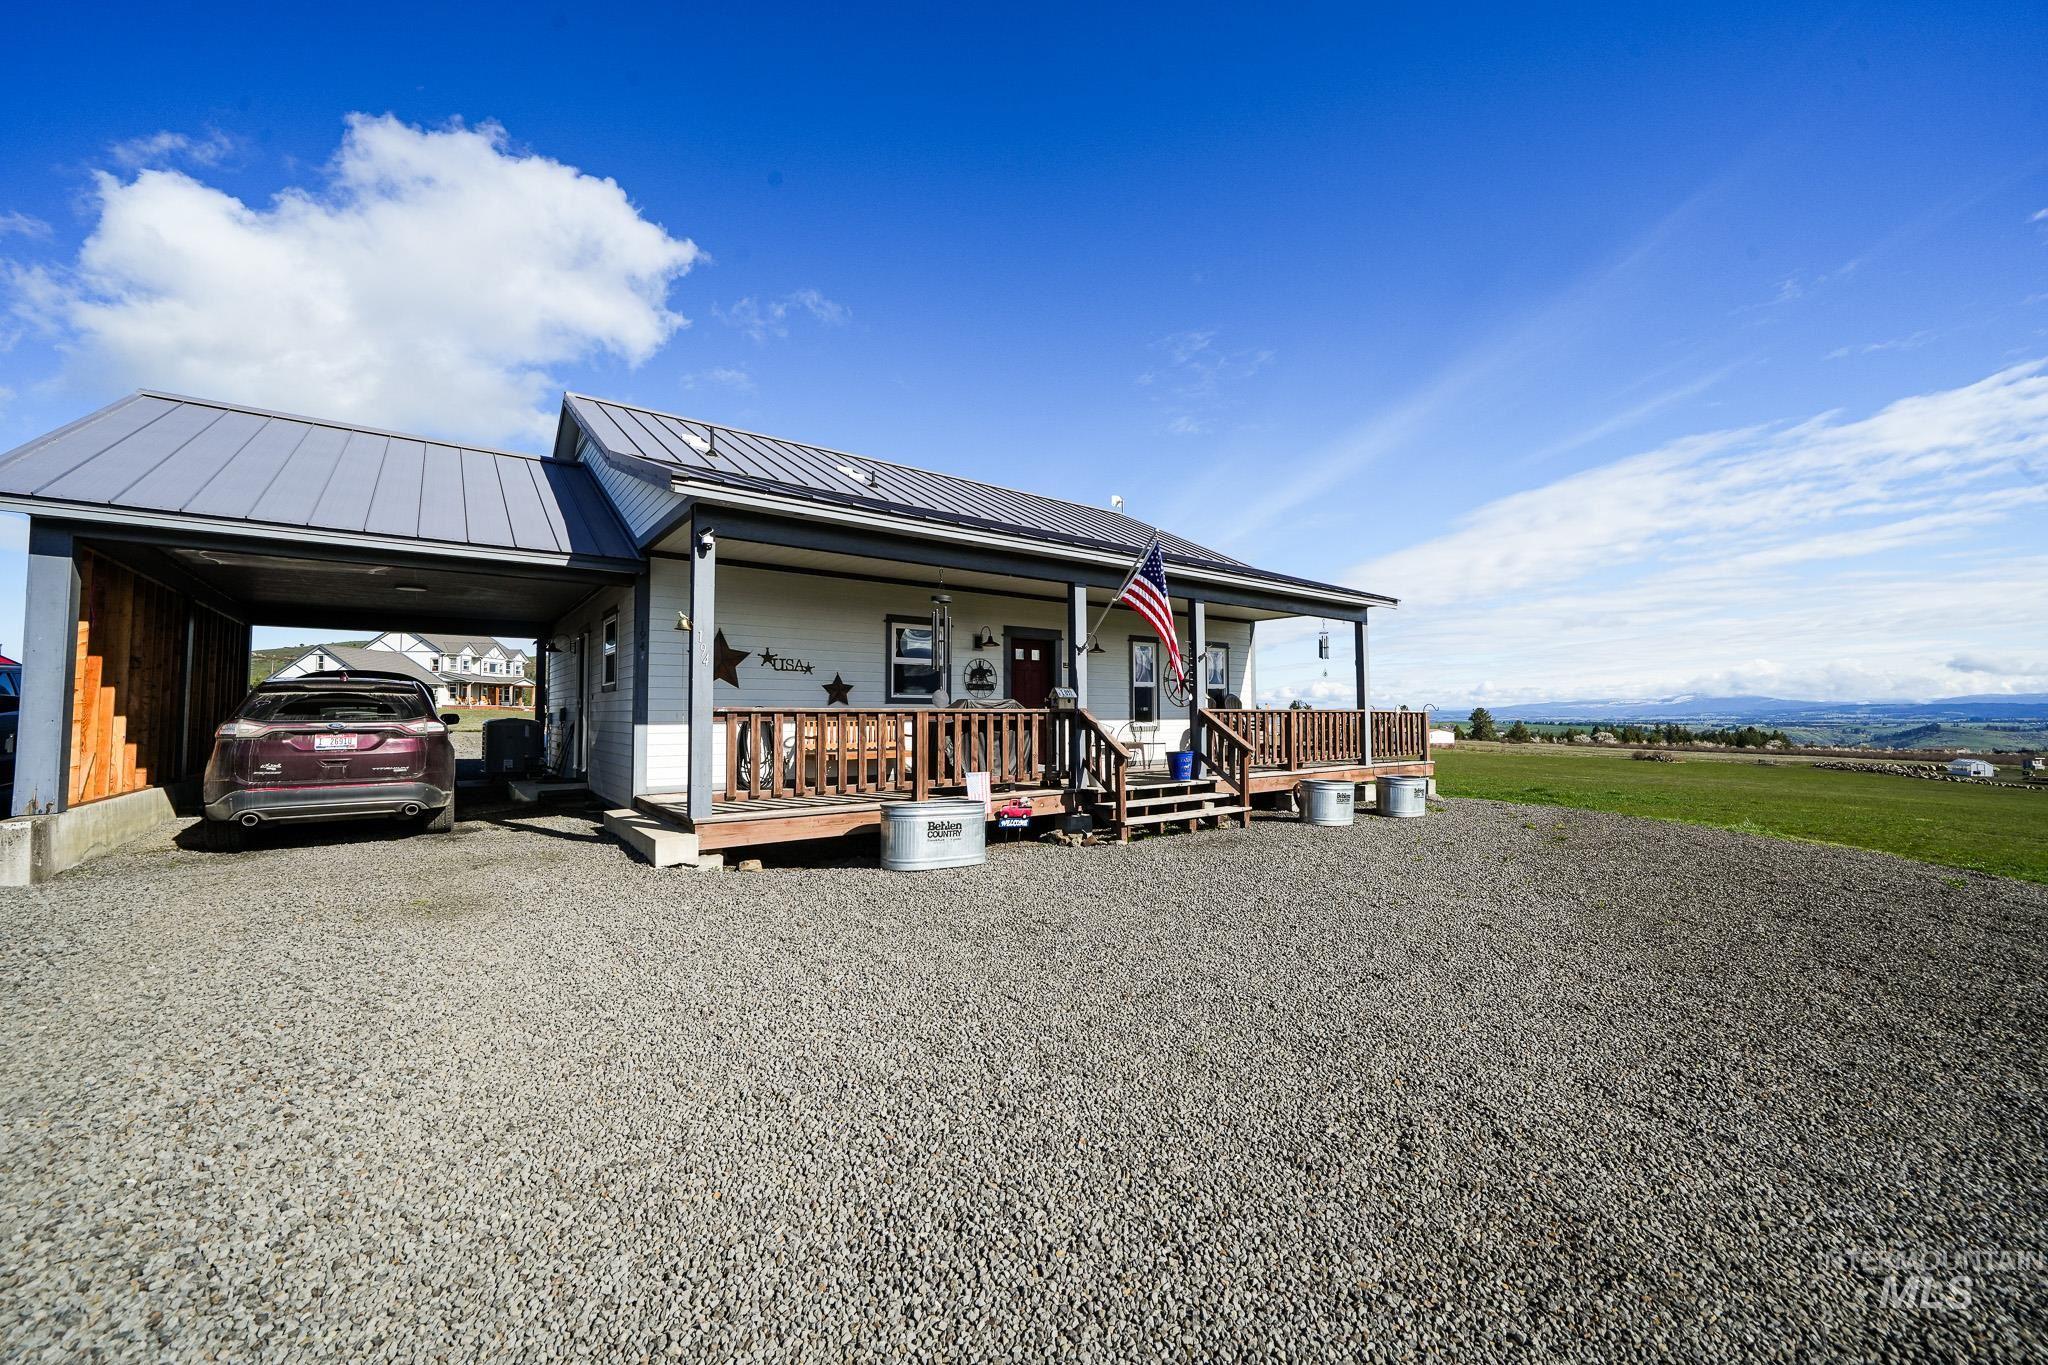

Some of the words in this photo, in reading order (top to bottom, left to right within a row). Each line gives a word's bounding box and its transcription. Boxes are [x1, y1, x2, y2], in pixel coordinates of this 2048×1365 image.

[698, 631, 710, 667] 194
[773, 659, 805, 672] USA
[928, 821, 962, 831] Behlen
[927, 830, 962, 839] COUNTRY
